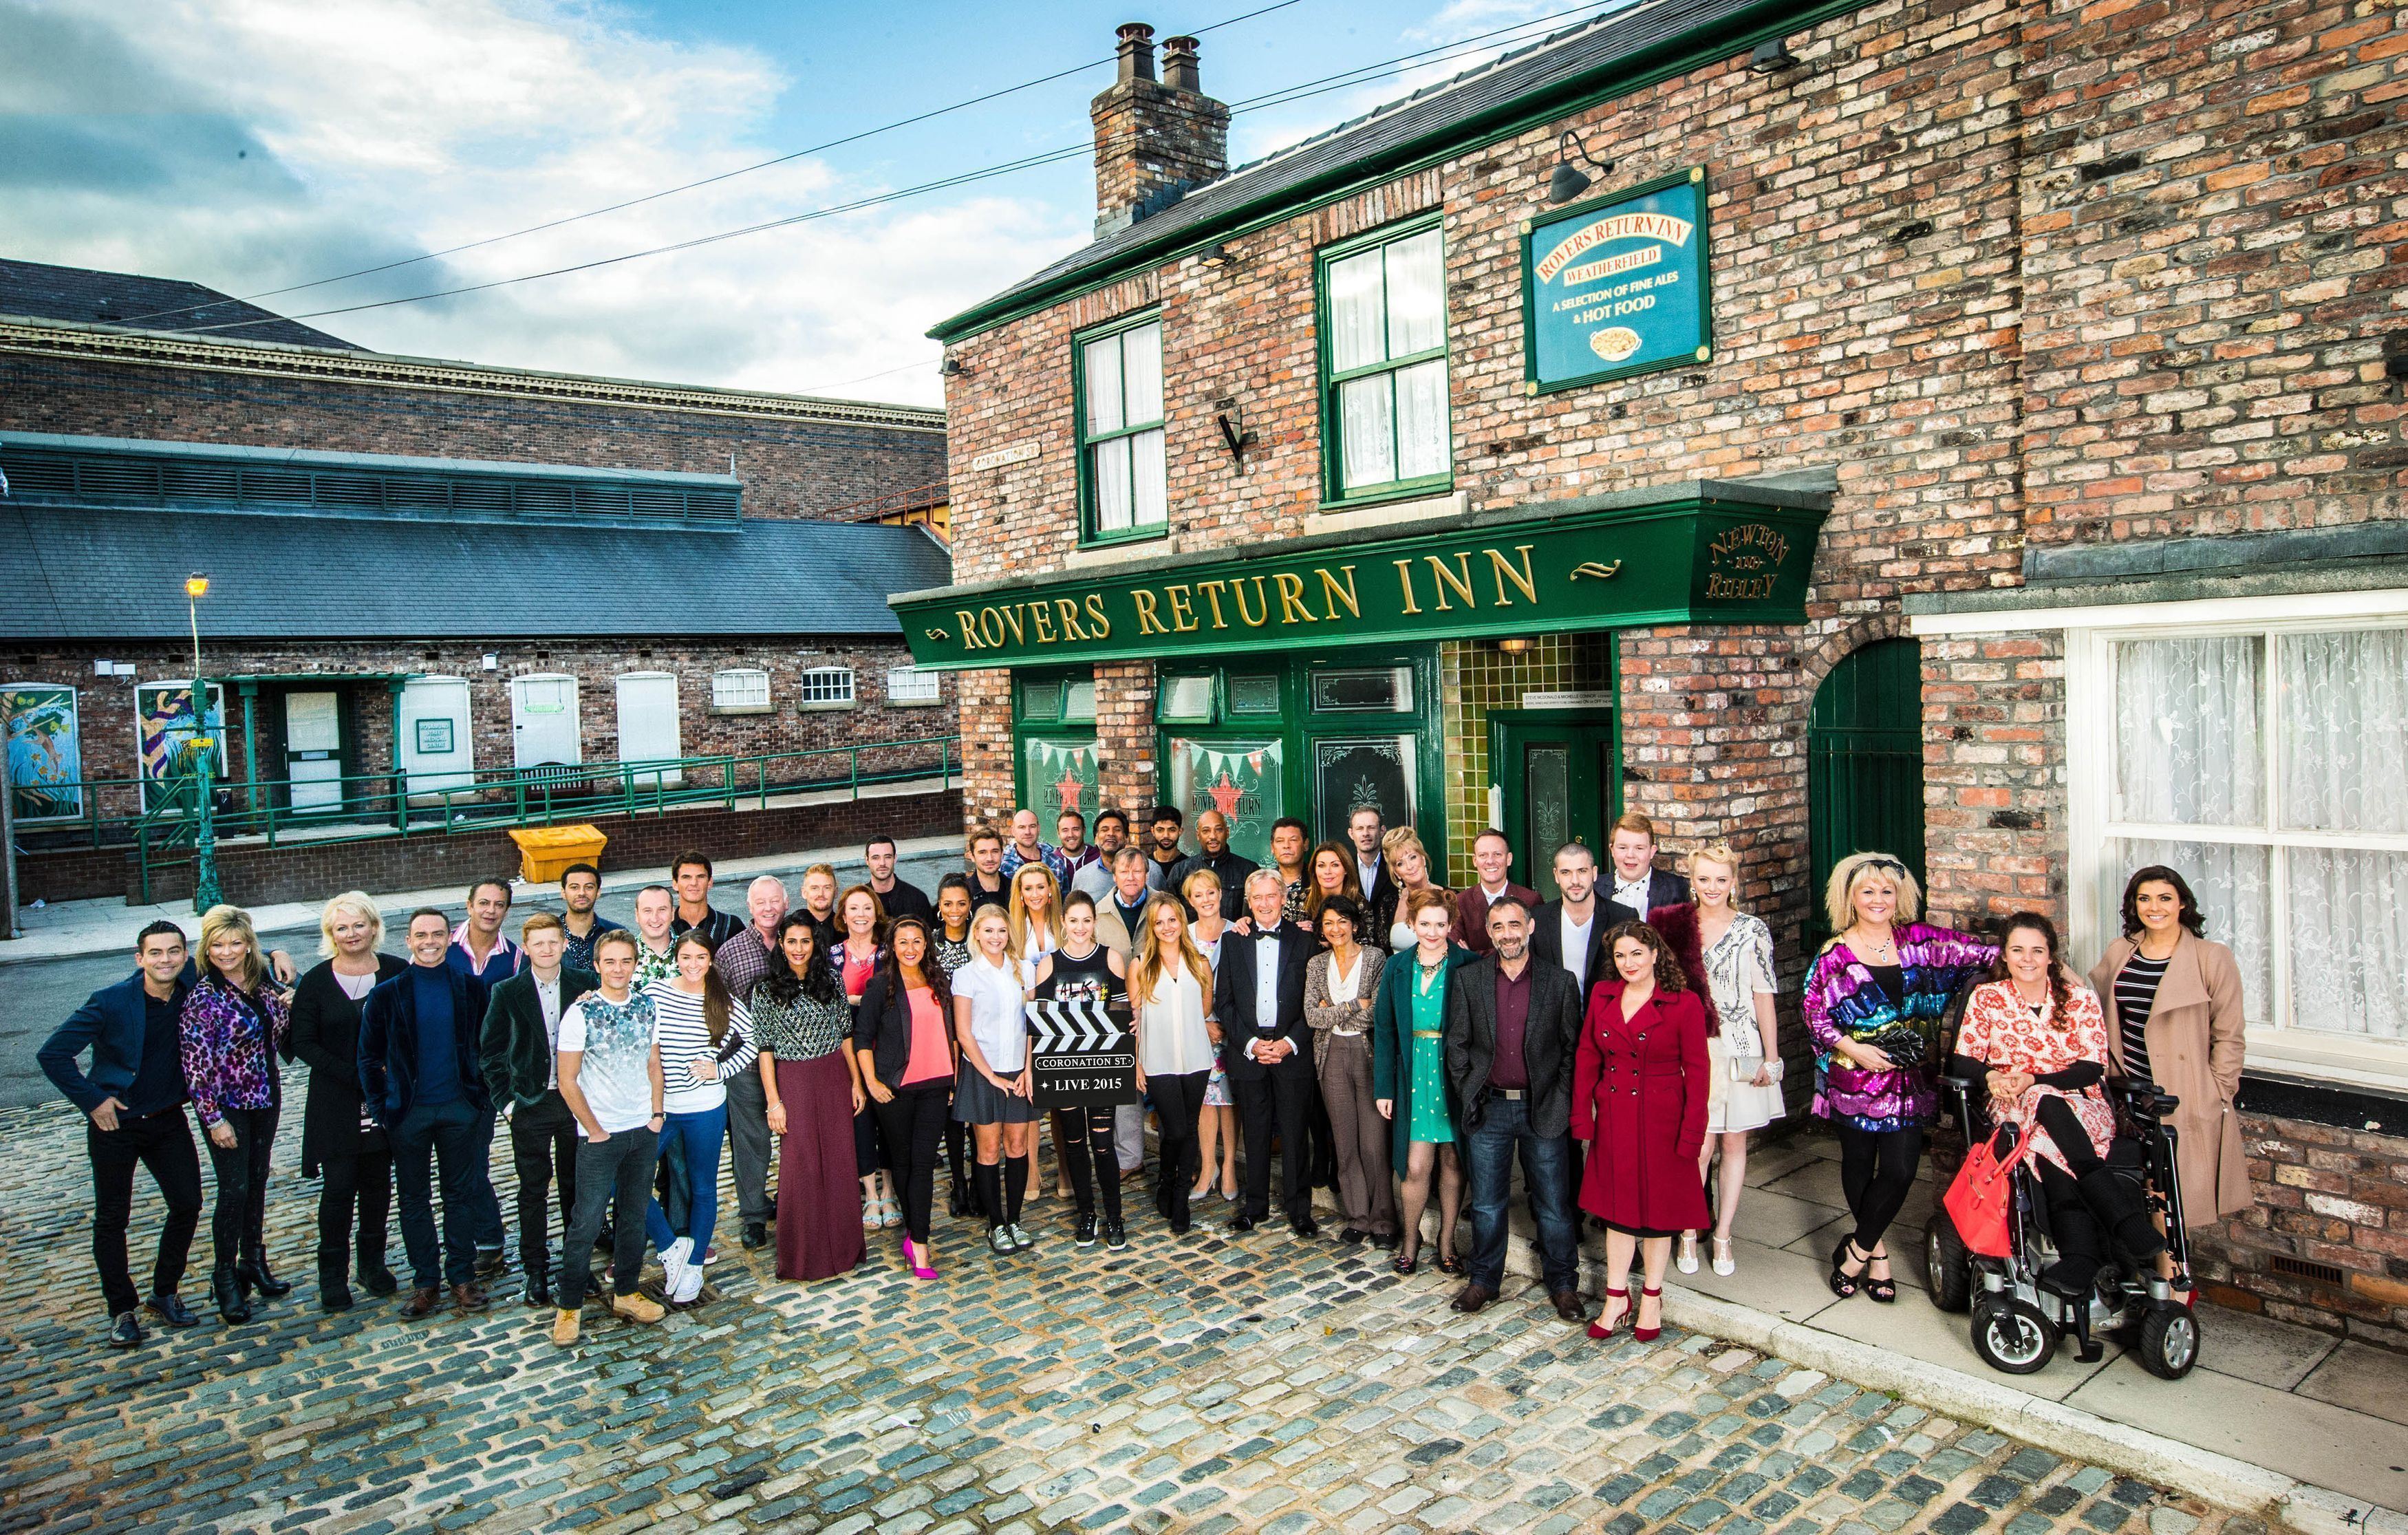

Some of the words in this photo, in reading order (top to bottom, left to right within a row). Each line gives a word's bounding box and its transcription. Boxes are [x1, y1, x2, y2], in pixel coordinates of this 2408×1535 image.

[1540, 229, 1592, 278] ROVERS
[1595, 216, 1655, 241] RETURN
[1657, 218, 1686, 241] INN
[1567, 248, 1657, 282] WEATHERFIELD
[1552, 302, 1561, 312] A
[1561, 288, 1613, 310] SELECTION
[1613, 284, 1628, 297] OF
[1630, 277, 1653, 293] FINE
[1654, 270, 1679, 287] ALES
[1573, 313, 1581, 324] &
[1582, 304, 1612, 324] HOT
[1615, 294, 1656, 316] FOOD
[1709, 524, 1790, 567] NEWTON
[1734, 555, 1761, 570] AND
[955, 593, 1111, 650] ROVERS
[1130, 565, 1361, 634] RETURN
[1392, 544, 1538, 614] INN
[1706, 572, 1778, 599] RIDLEY
[1044, 788, 1068, 804] ROVERS
[1069, 788, 1097, 805] RETURN
[1192, 795, 1223, 813] ROVERS
[1226, 796, 1261, 815] RETURN
[1042, 1058, 1111, 1068] CORONATION
[1054, 1078, 1090, 1091] LIVE
[1093, 1077, 1122, 1090] 2015
